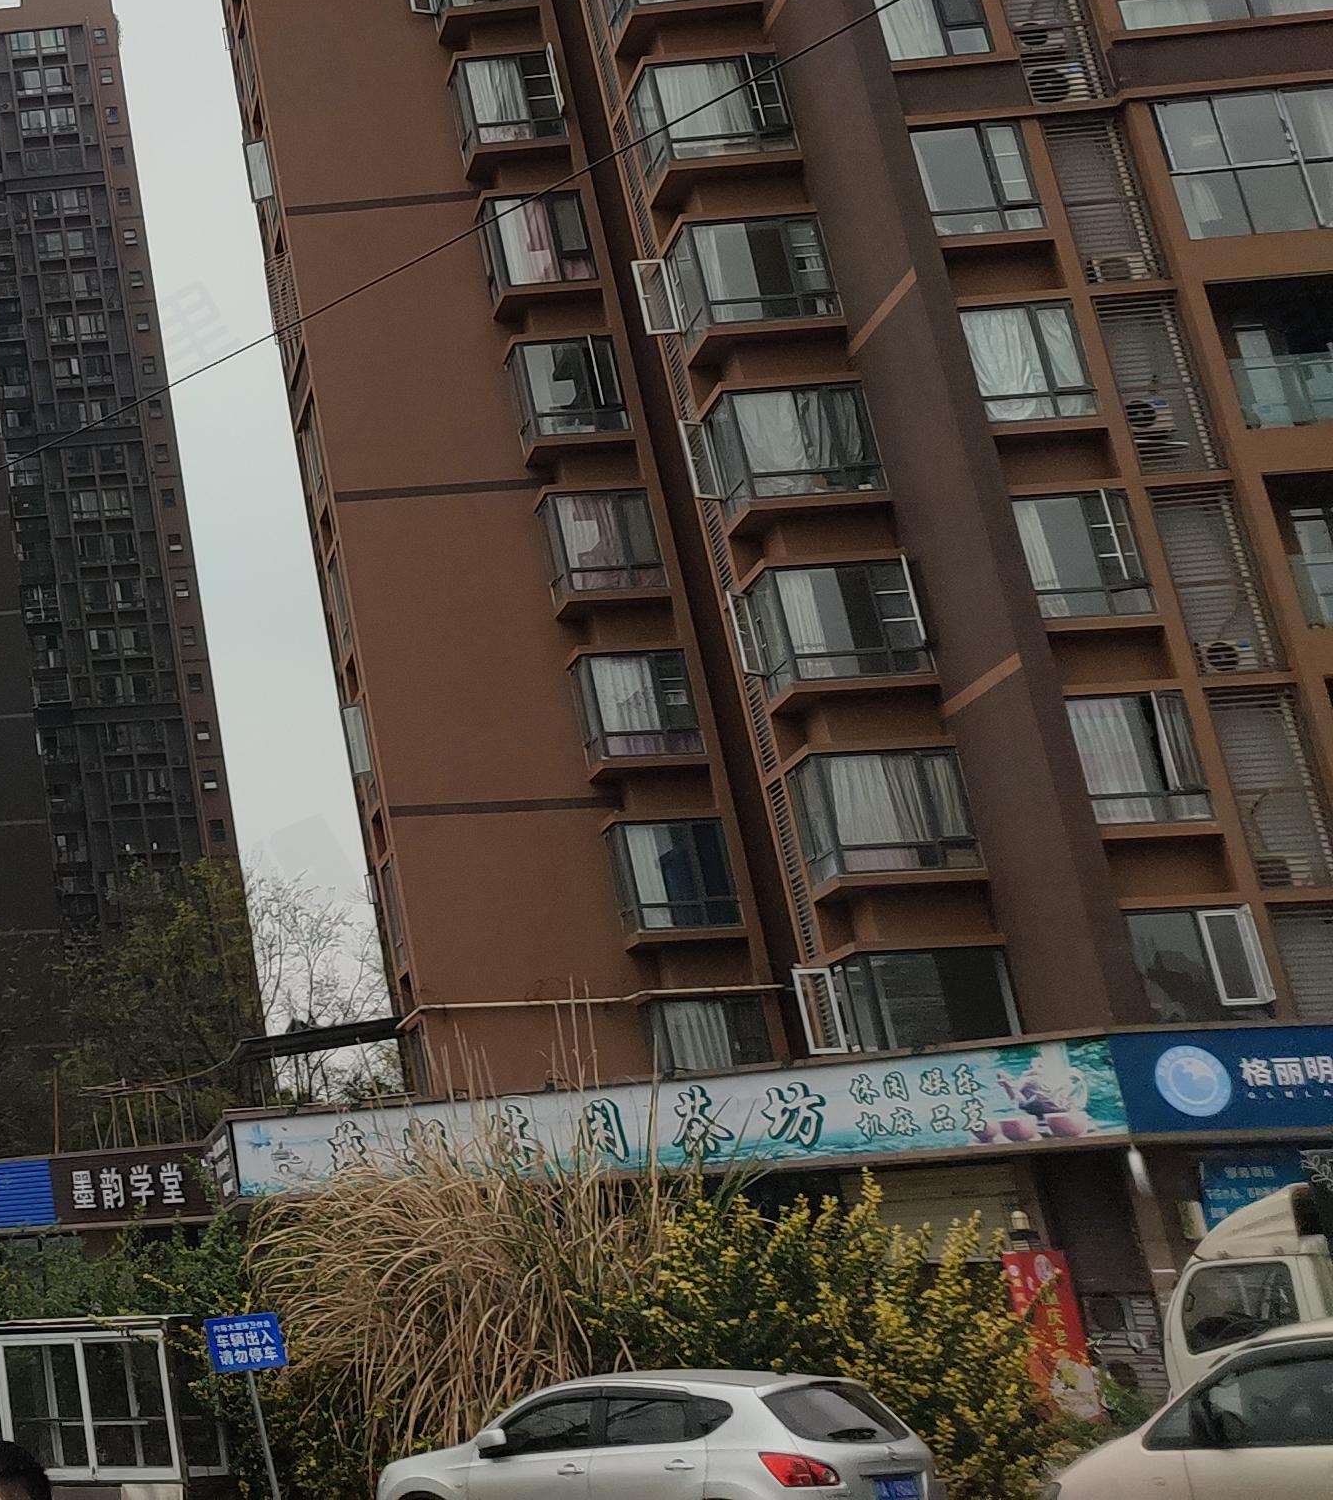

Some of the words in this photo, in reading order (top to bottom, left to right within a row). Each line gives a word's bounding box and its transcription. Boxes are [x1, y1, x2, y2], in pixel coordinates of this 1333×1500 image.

[849, 1063, 983, 1106] 休闲娱乐
[1239, 1055, 1333, 1087] 格丽明
[71, 1162, 186, 1211] 墨韵学堂
[215, 1330, 275, 1349] 车辆出入
[219, 1345, 279, 1366] 请勿停车
